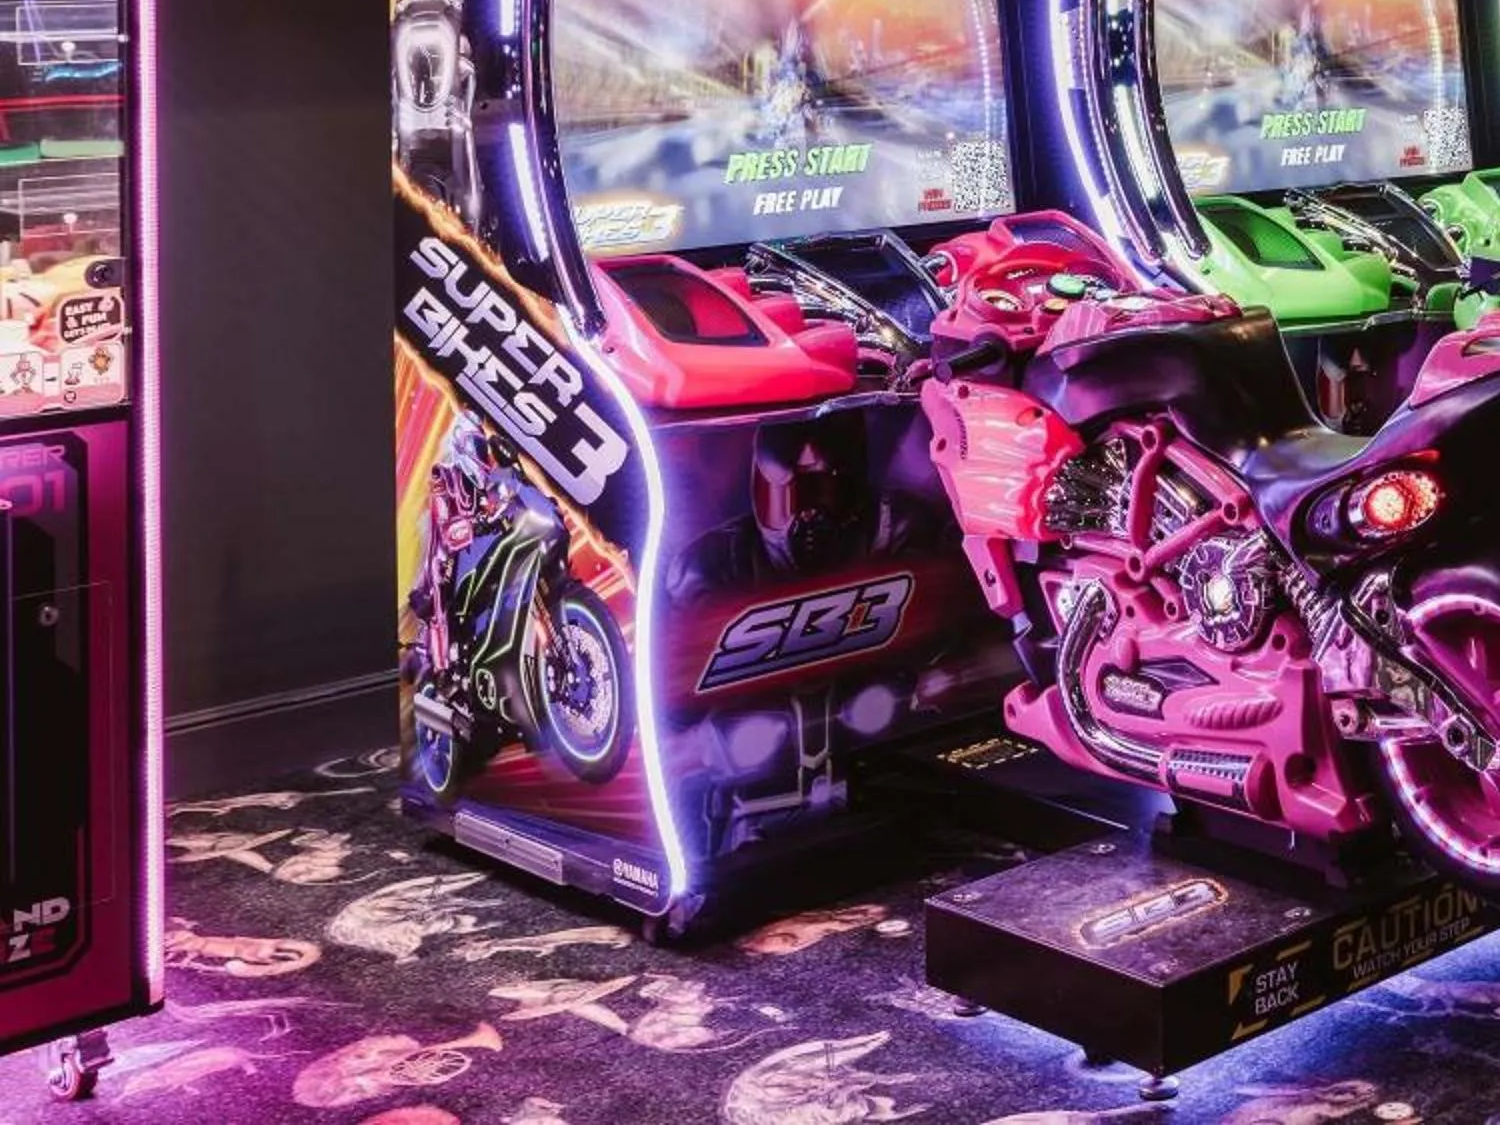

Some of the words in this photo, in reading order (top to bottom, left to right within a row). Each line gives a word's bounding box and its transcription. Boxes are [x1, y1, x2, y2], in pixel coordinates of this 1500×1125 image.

[1259, 112, 1313, 140] PRESS
[1317, 108, 1367, 134] START
[723, 149, 800, 185] PRESS
[804, 144, 873, 177] START
[1280, 146, 1313, 166] FREE
[1314, 143, 1347, 163] PLAY
[752, 190, 798, 215] FREE
[799, 186, 844, 211] PLAY
[409, 237, 583, 408] SUPER
[403, 287, 558, 437] BIKES
[700, 574, 913, 691] SB3
[1352, 947, 1402, 979] WATCH
[1402, 930, 1438, 957] YOUR
[1438, 916, 1471, 942] STEP
[1254, 962, 1300, 995] STAY
[1254, 984, 1300, 1016] BACK
